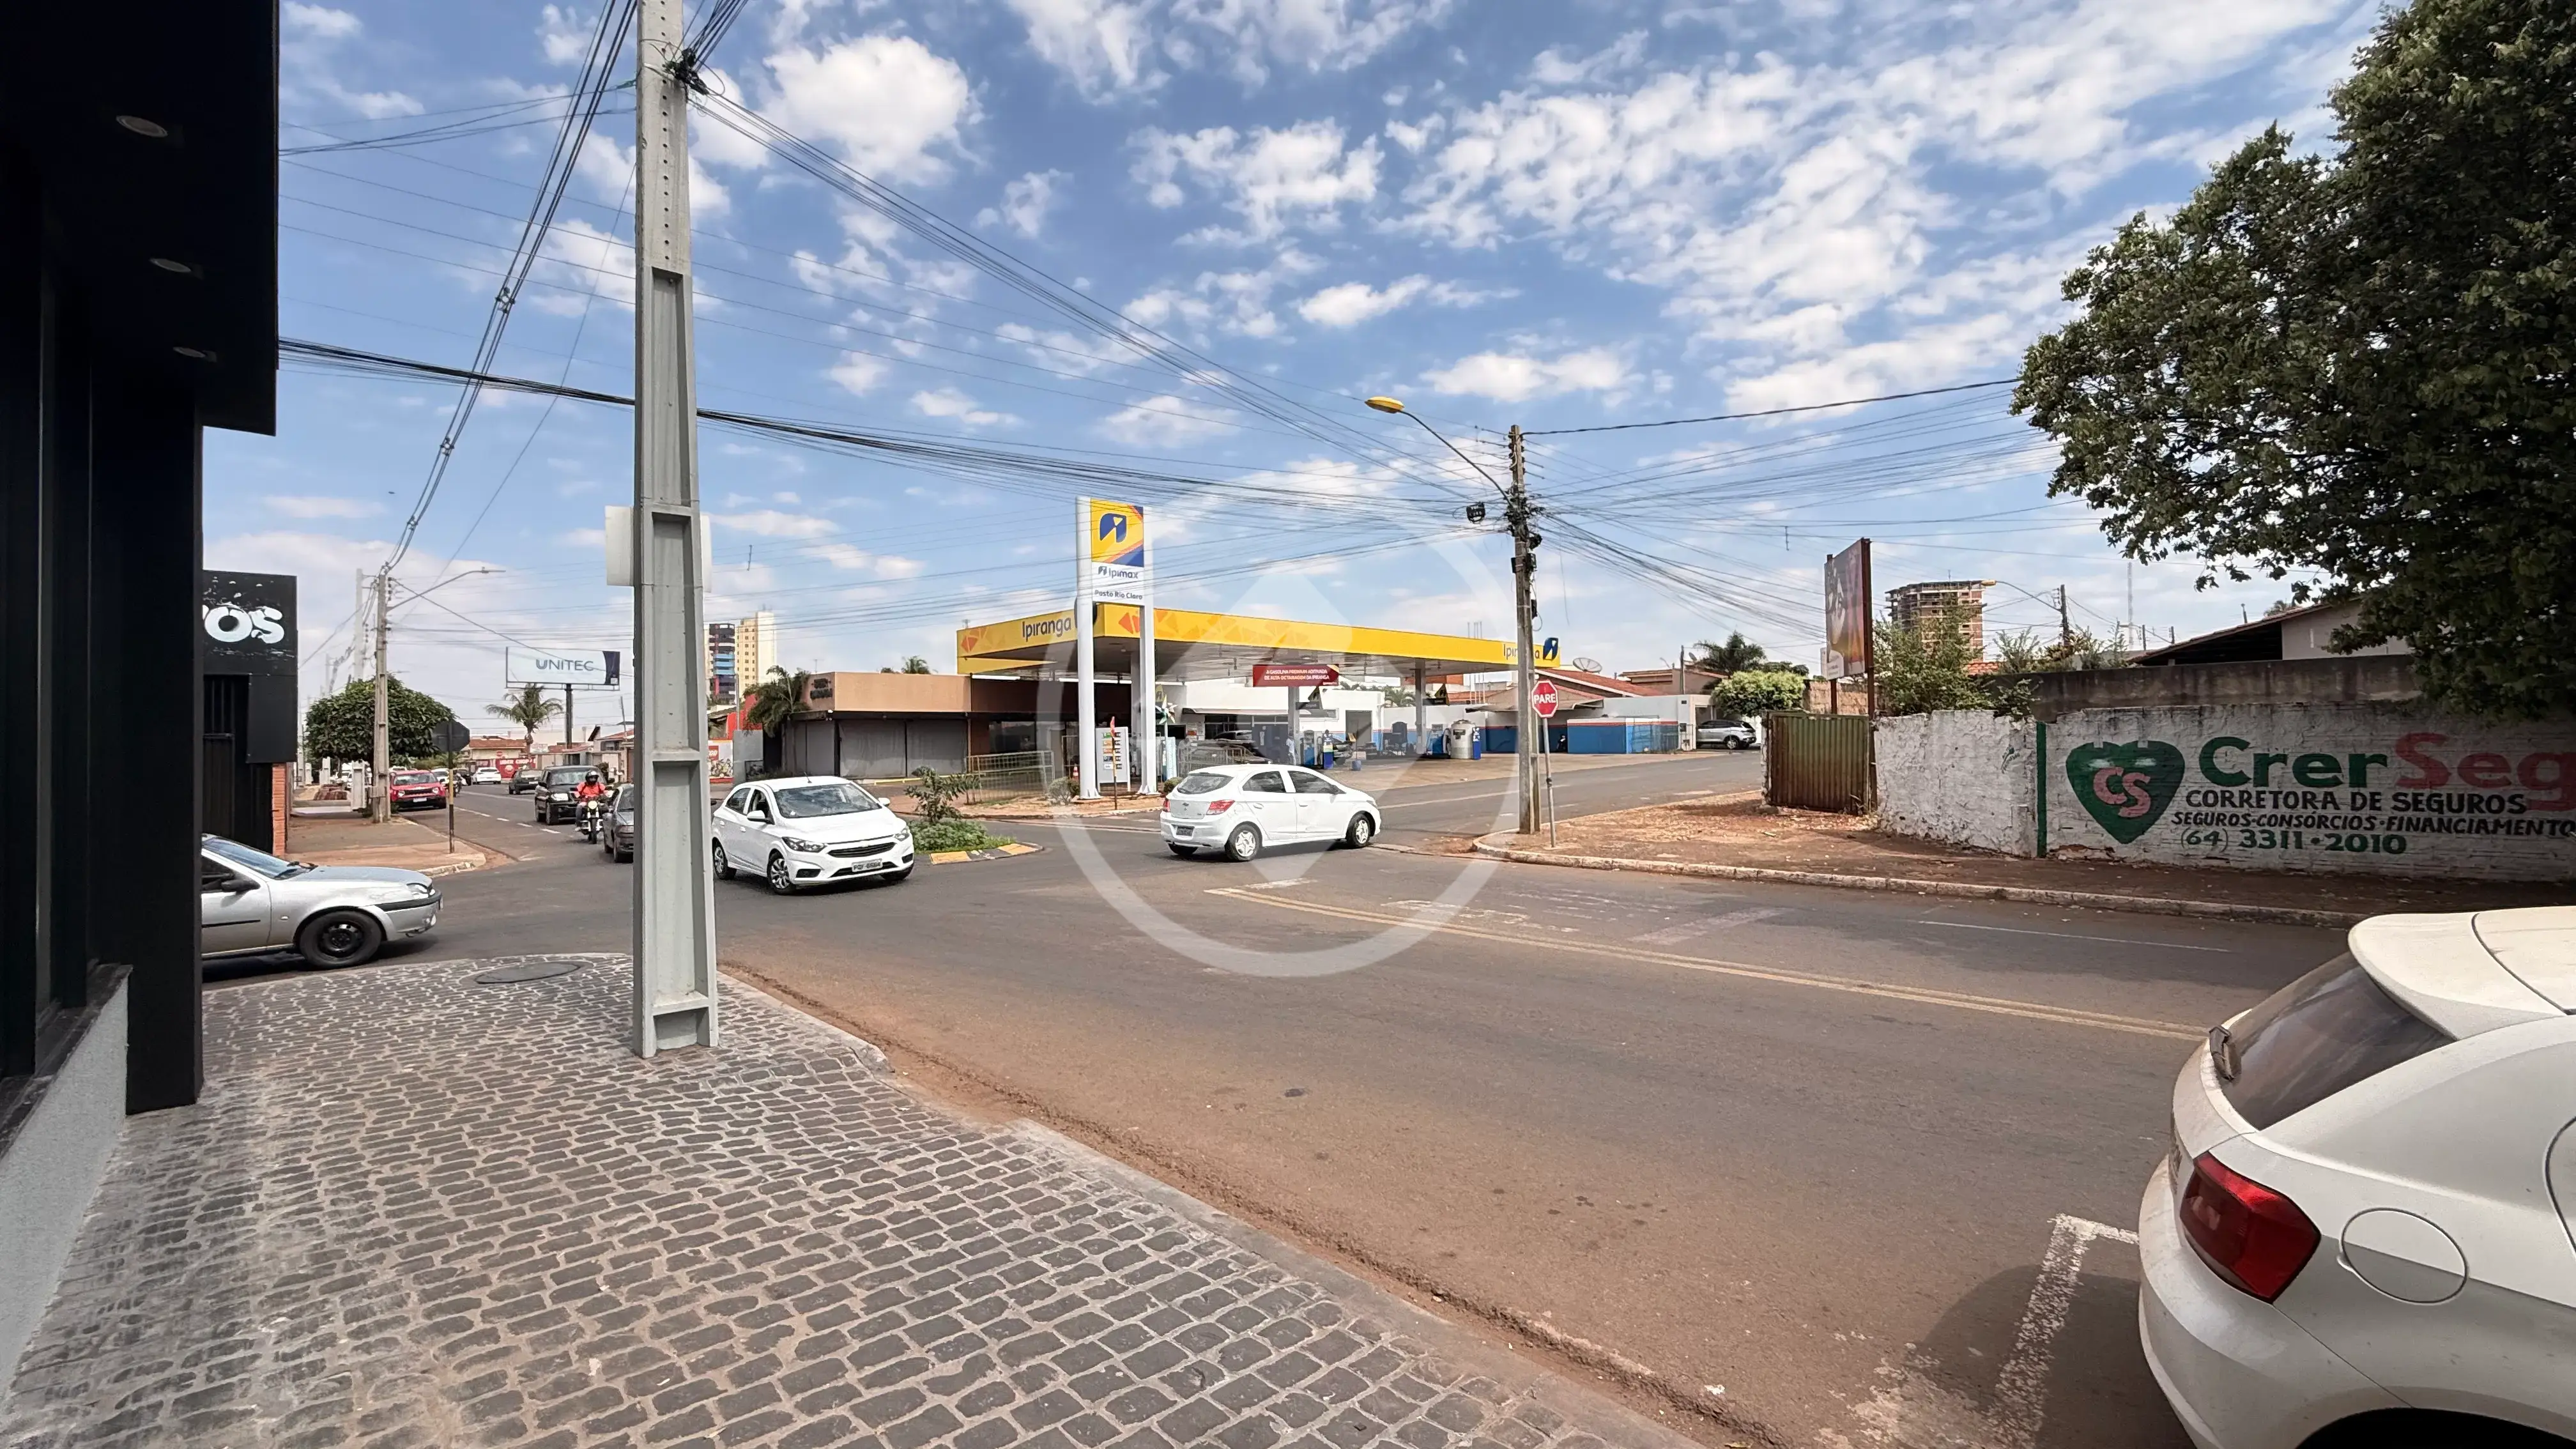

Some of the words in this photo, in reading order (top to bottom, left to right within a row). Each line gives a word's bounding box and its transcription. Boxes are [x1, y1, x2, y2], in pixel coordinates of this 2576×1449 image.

[1108, 567, 1138, 579] Ipimax
[1094, 589, 1114, 597] Posto
[1022, 617, 1072, 643] Ipiranga
[1503, 643, 1540, 661] Ipira
[535, 659, 594, 671] UNITEC
[1533, 693, 1556, 704] PARE
[2093, 766, 2151, 818] CS
[2186, 789, 2340, 811] CORRETORA
[2350, 791, 2382, 812] DE
[2391, 792, 2528, 815] SEGUROS
[2181, 828, 2228, 853] (64)
